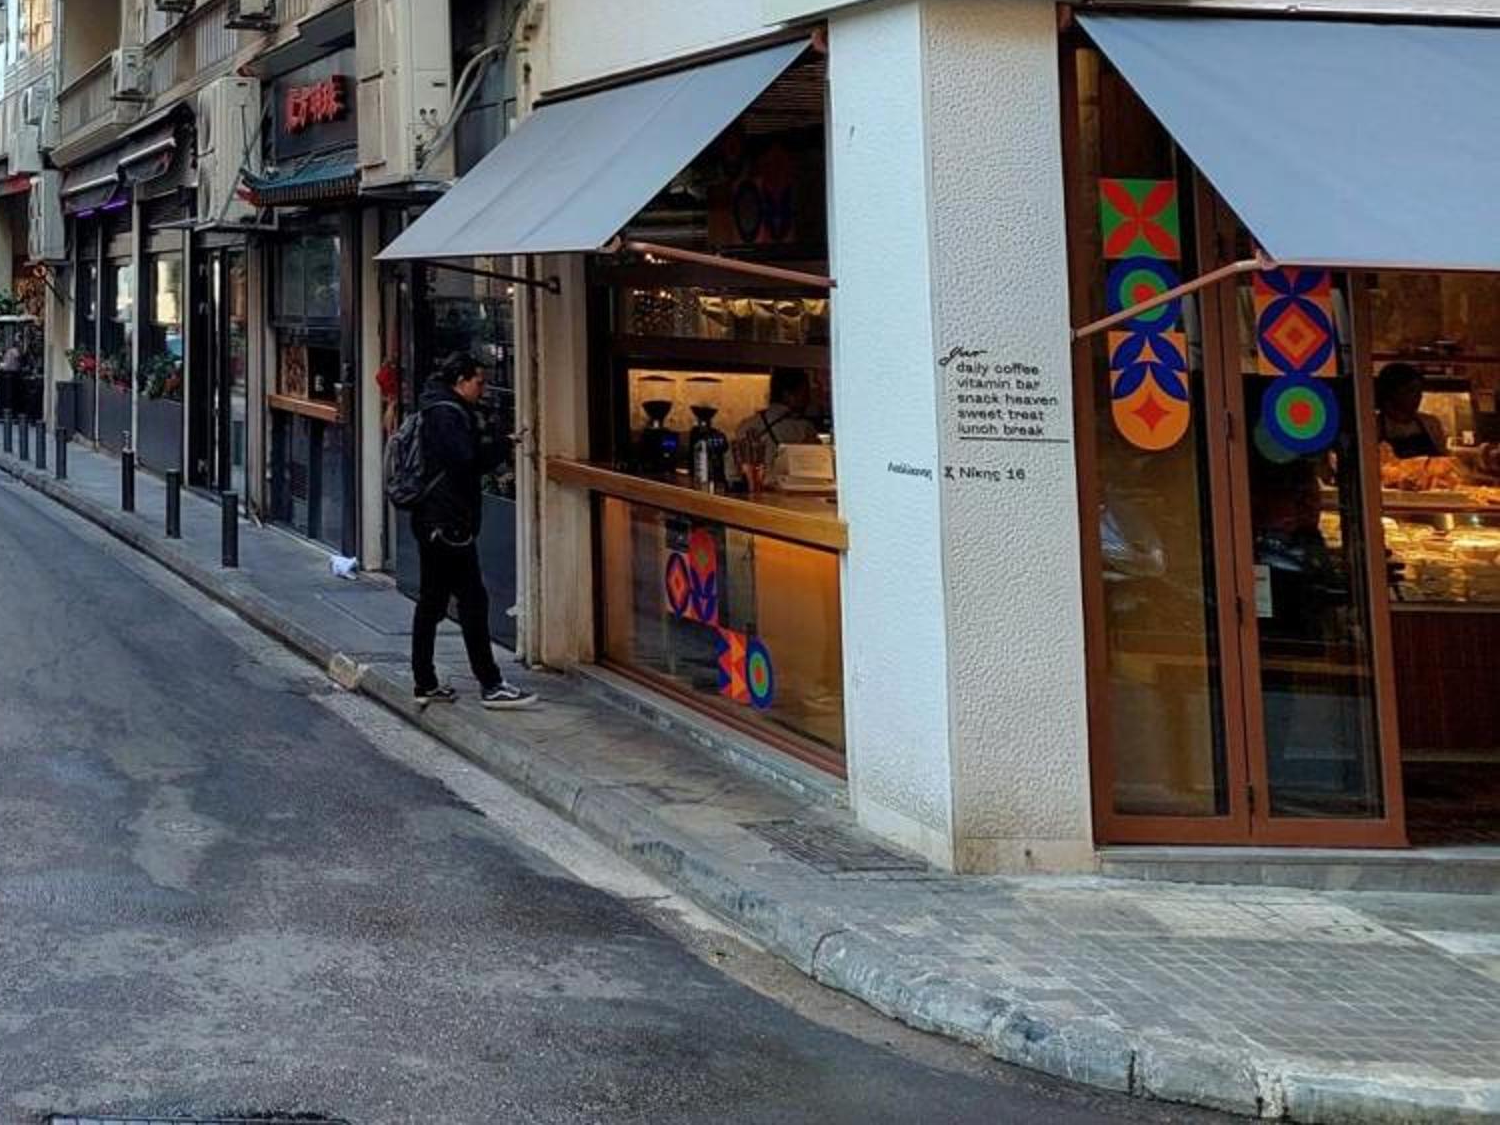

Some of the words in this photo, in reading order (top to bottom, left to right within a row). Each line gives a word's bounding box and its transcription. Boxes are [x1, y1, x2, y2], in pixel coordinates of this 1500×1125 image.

[956, 361, 988, 377] daily
[994, 363, 1039, 375] coffee
[957, 378, 1011, 389] vitamin
[1016, 379, 1041, 390] bar
[957, 393, 999, 405] snack
[1005, 393, 1059, 406] heaven
[957, 409, 1002, 420] sweet
[1008, 409, 1045, 422] treat
[957, 424, 998, 435] lunch
[1003, 424, 1045, 436] break
[1006, 467, 1026, 480] 16
